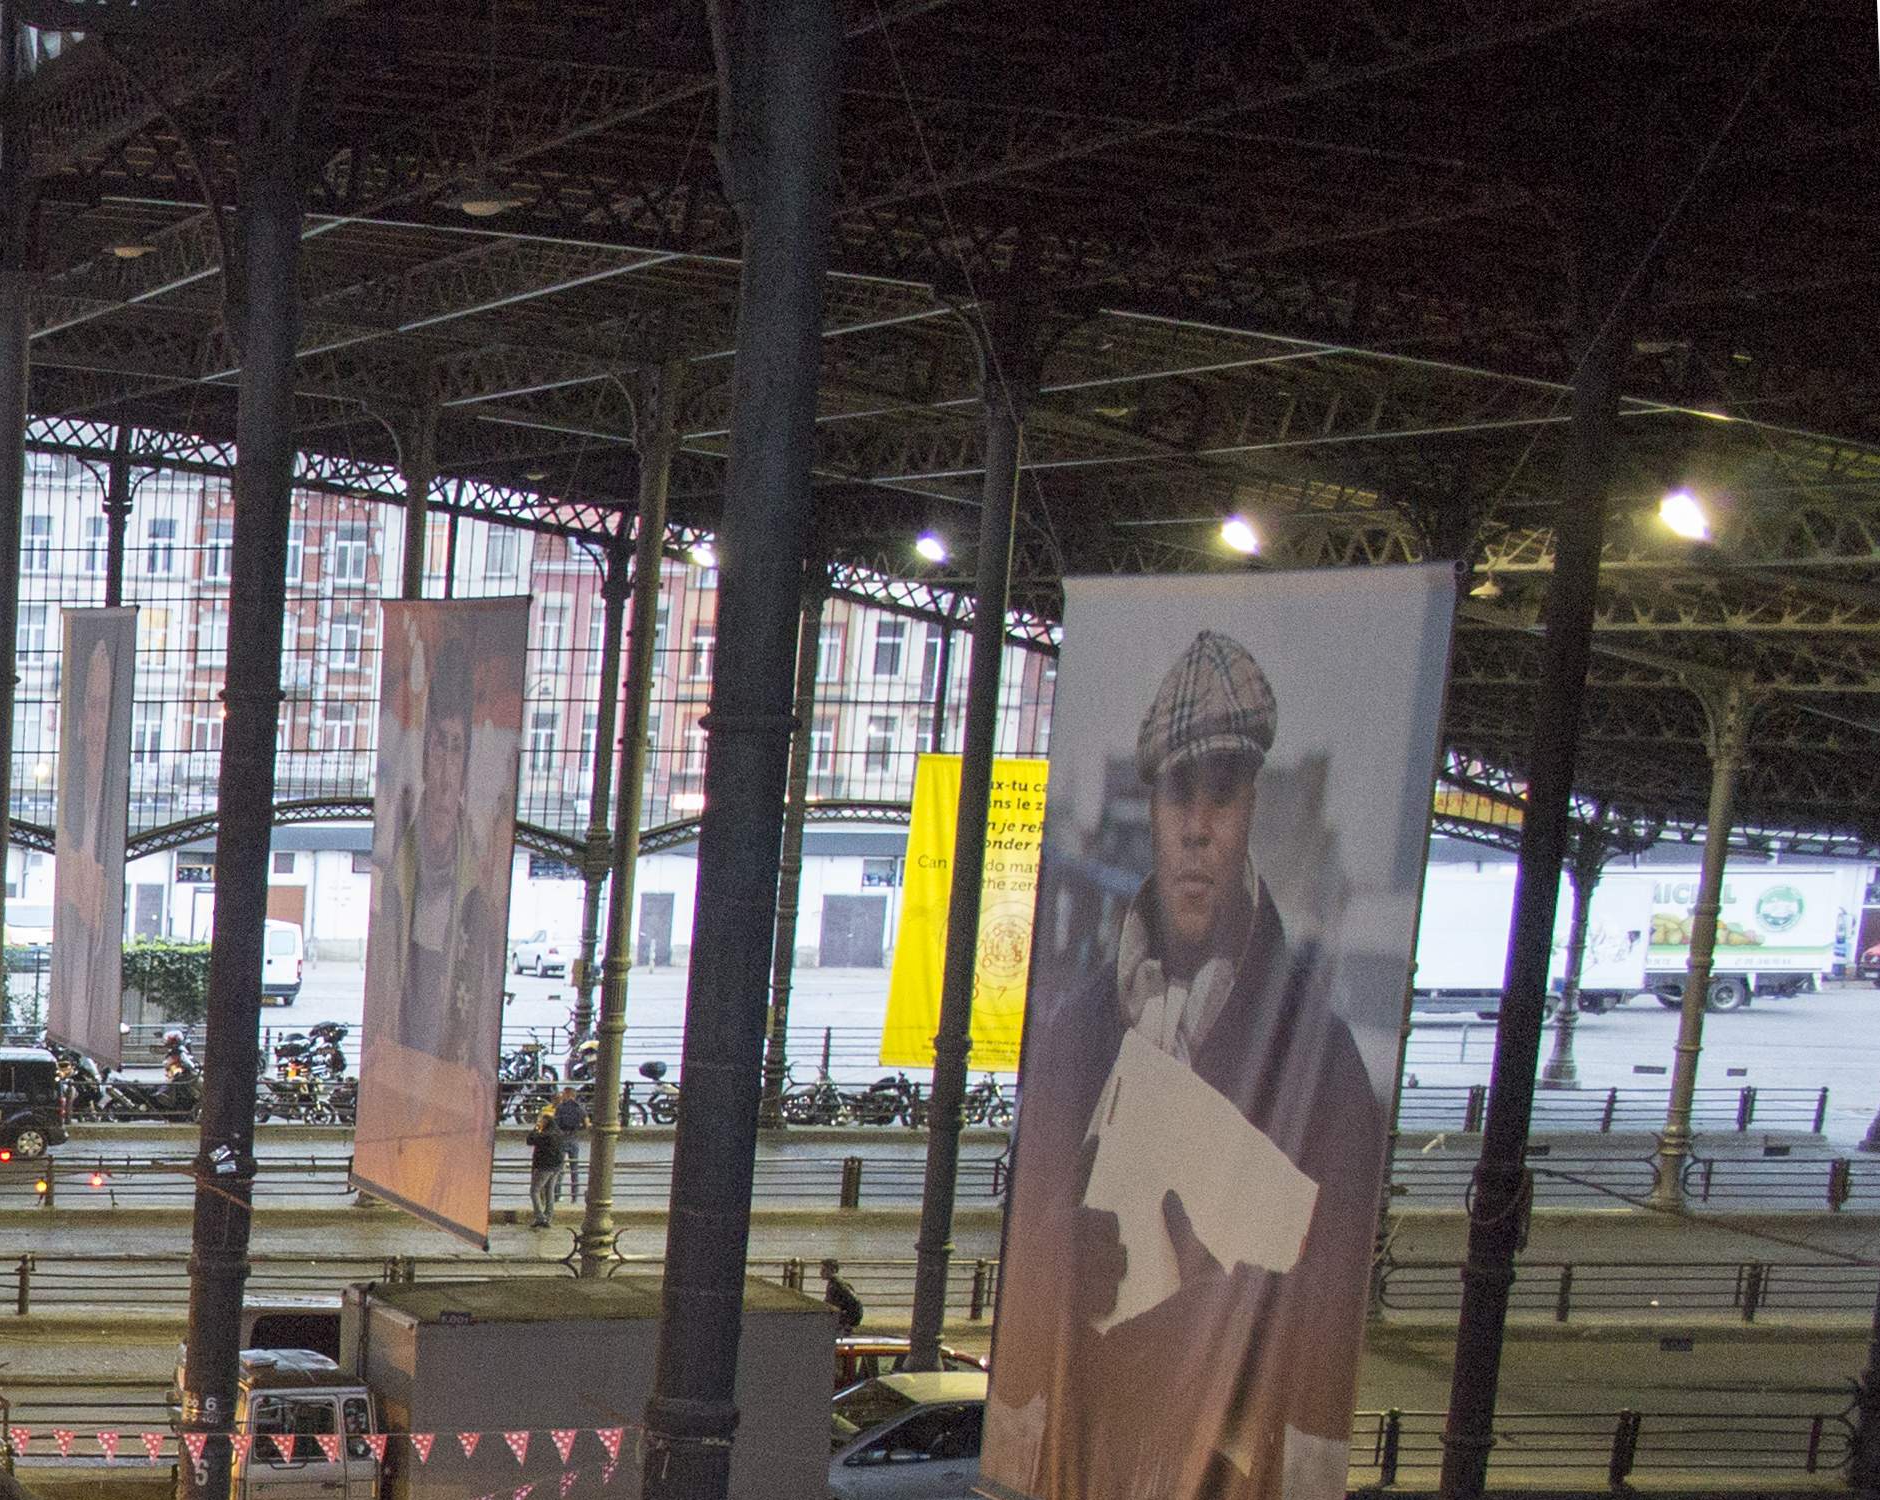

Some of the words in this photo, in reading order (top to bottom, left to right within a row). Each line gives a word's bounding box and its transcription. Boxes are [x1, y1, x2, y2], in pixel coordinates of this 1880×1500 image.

[917, 854, 947, 869] Can
[205, 1396, 217, 1411] 6
[195, 1458, 209, 1487] 6
